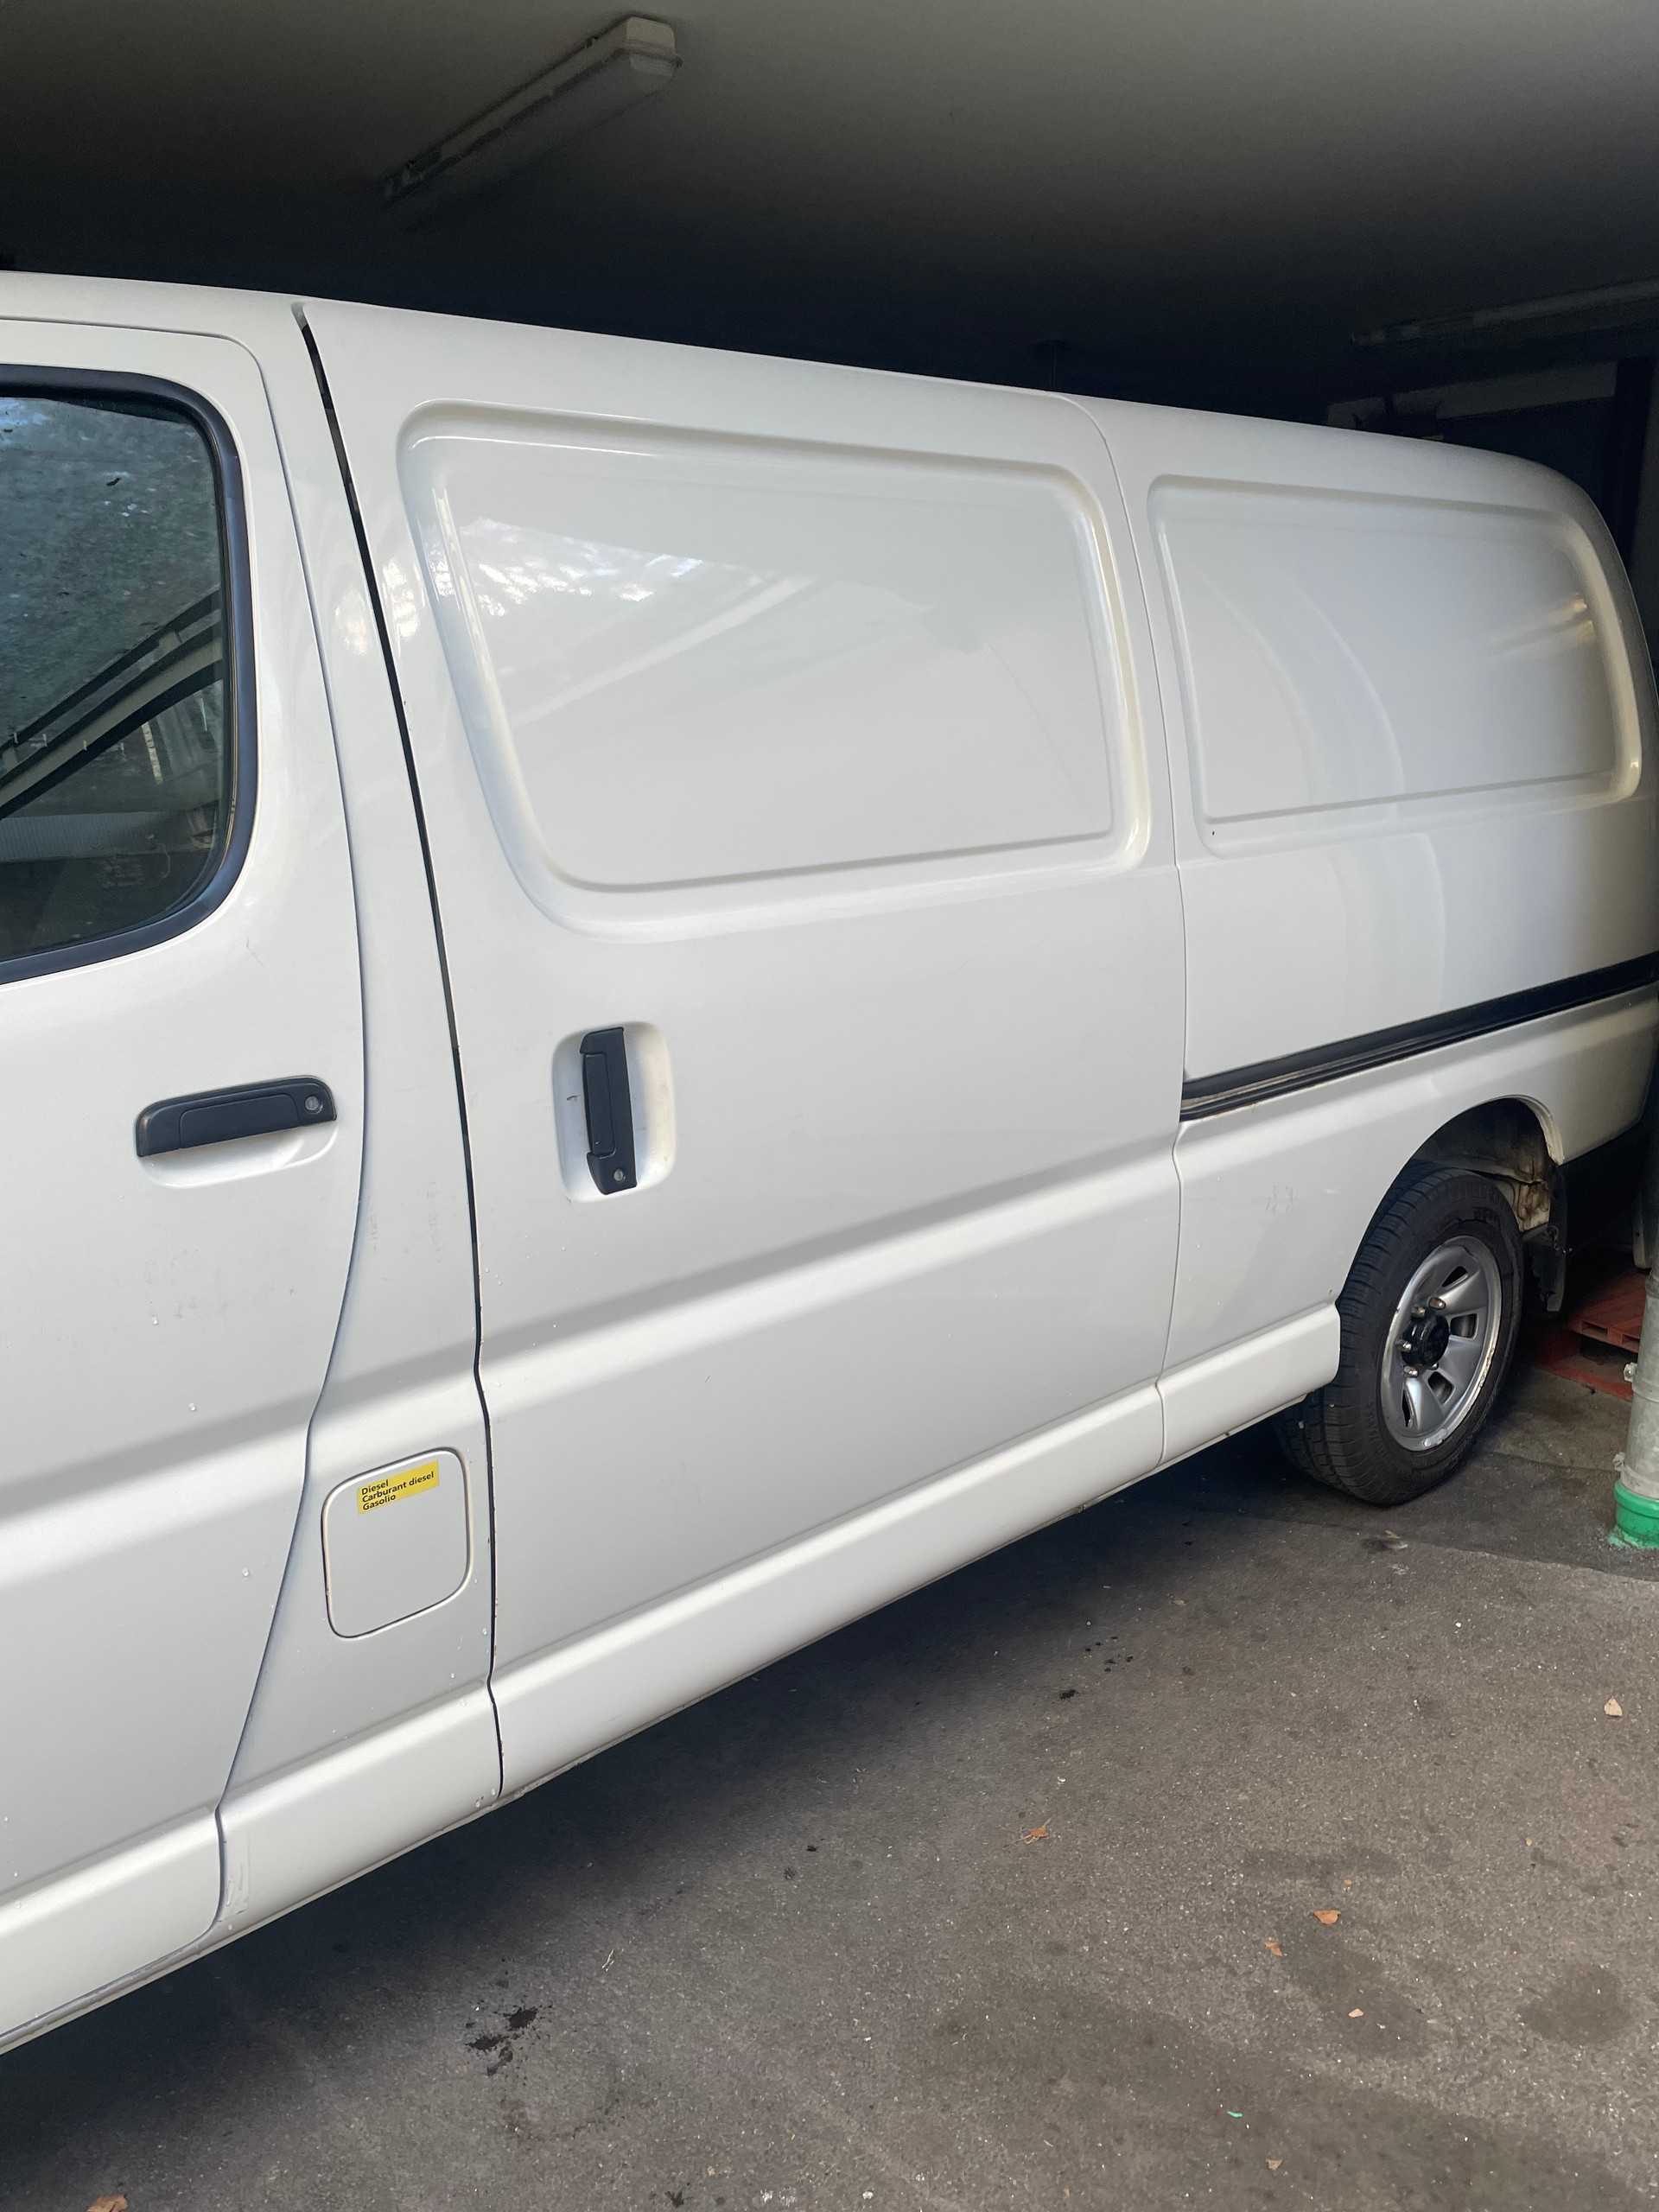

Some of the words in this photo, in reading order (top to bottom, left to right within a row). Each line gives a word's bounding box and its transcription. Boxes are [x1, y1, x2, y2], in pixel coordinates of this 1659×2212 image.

[361, 1479, 389, 1495] Diesel
[362, 1481, 407, 1503] Carburant
[409, 1471, 435, 1486] diesel
[362, 1494, 397, 1510] Gasolio
